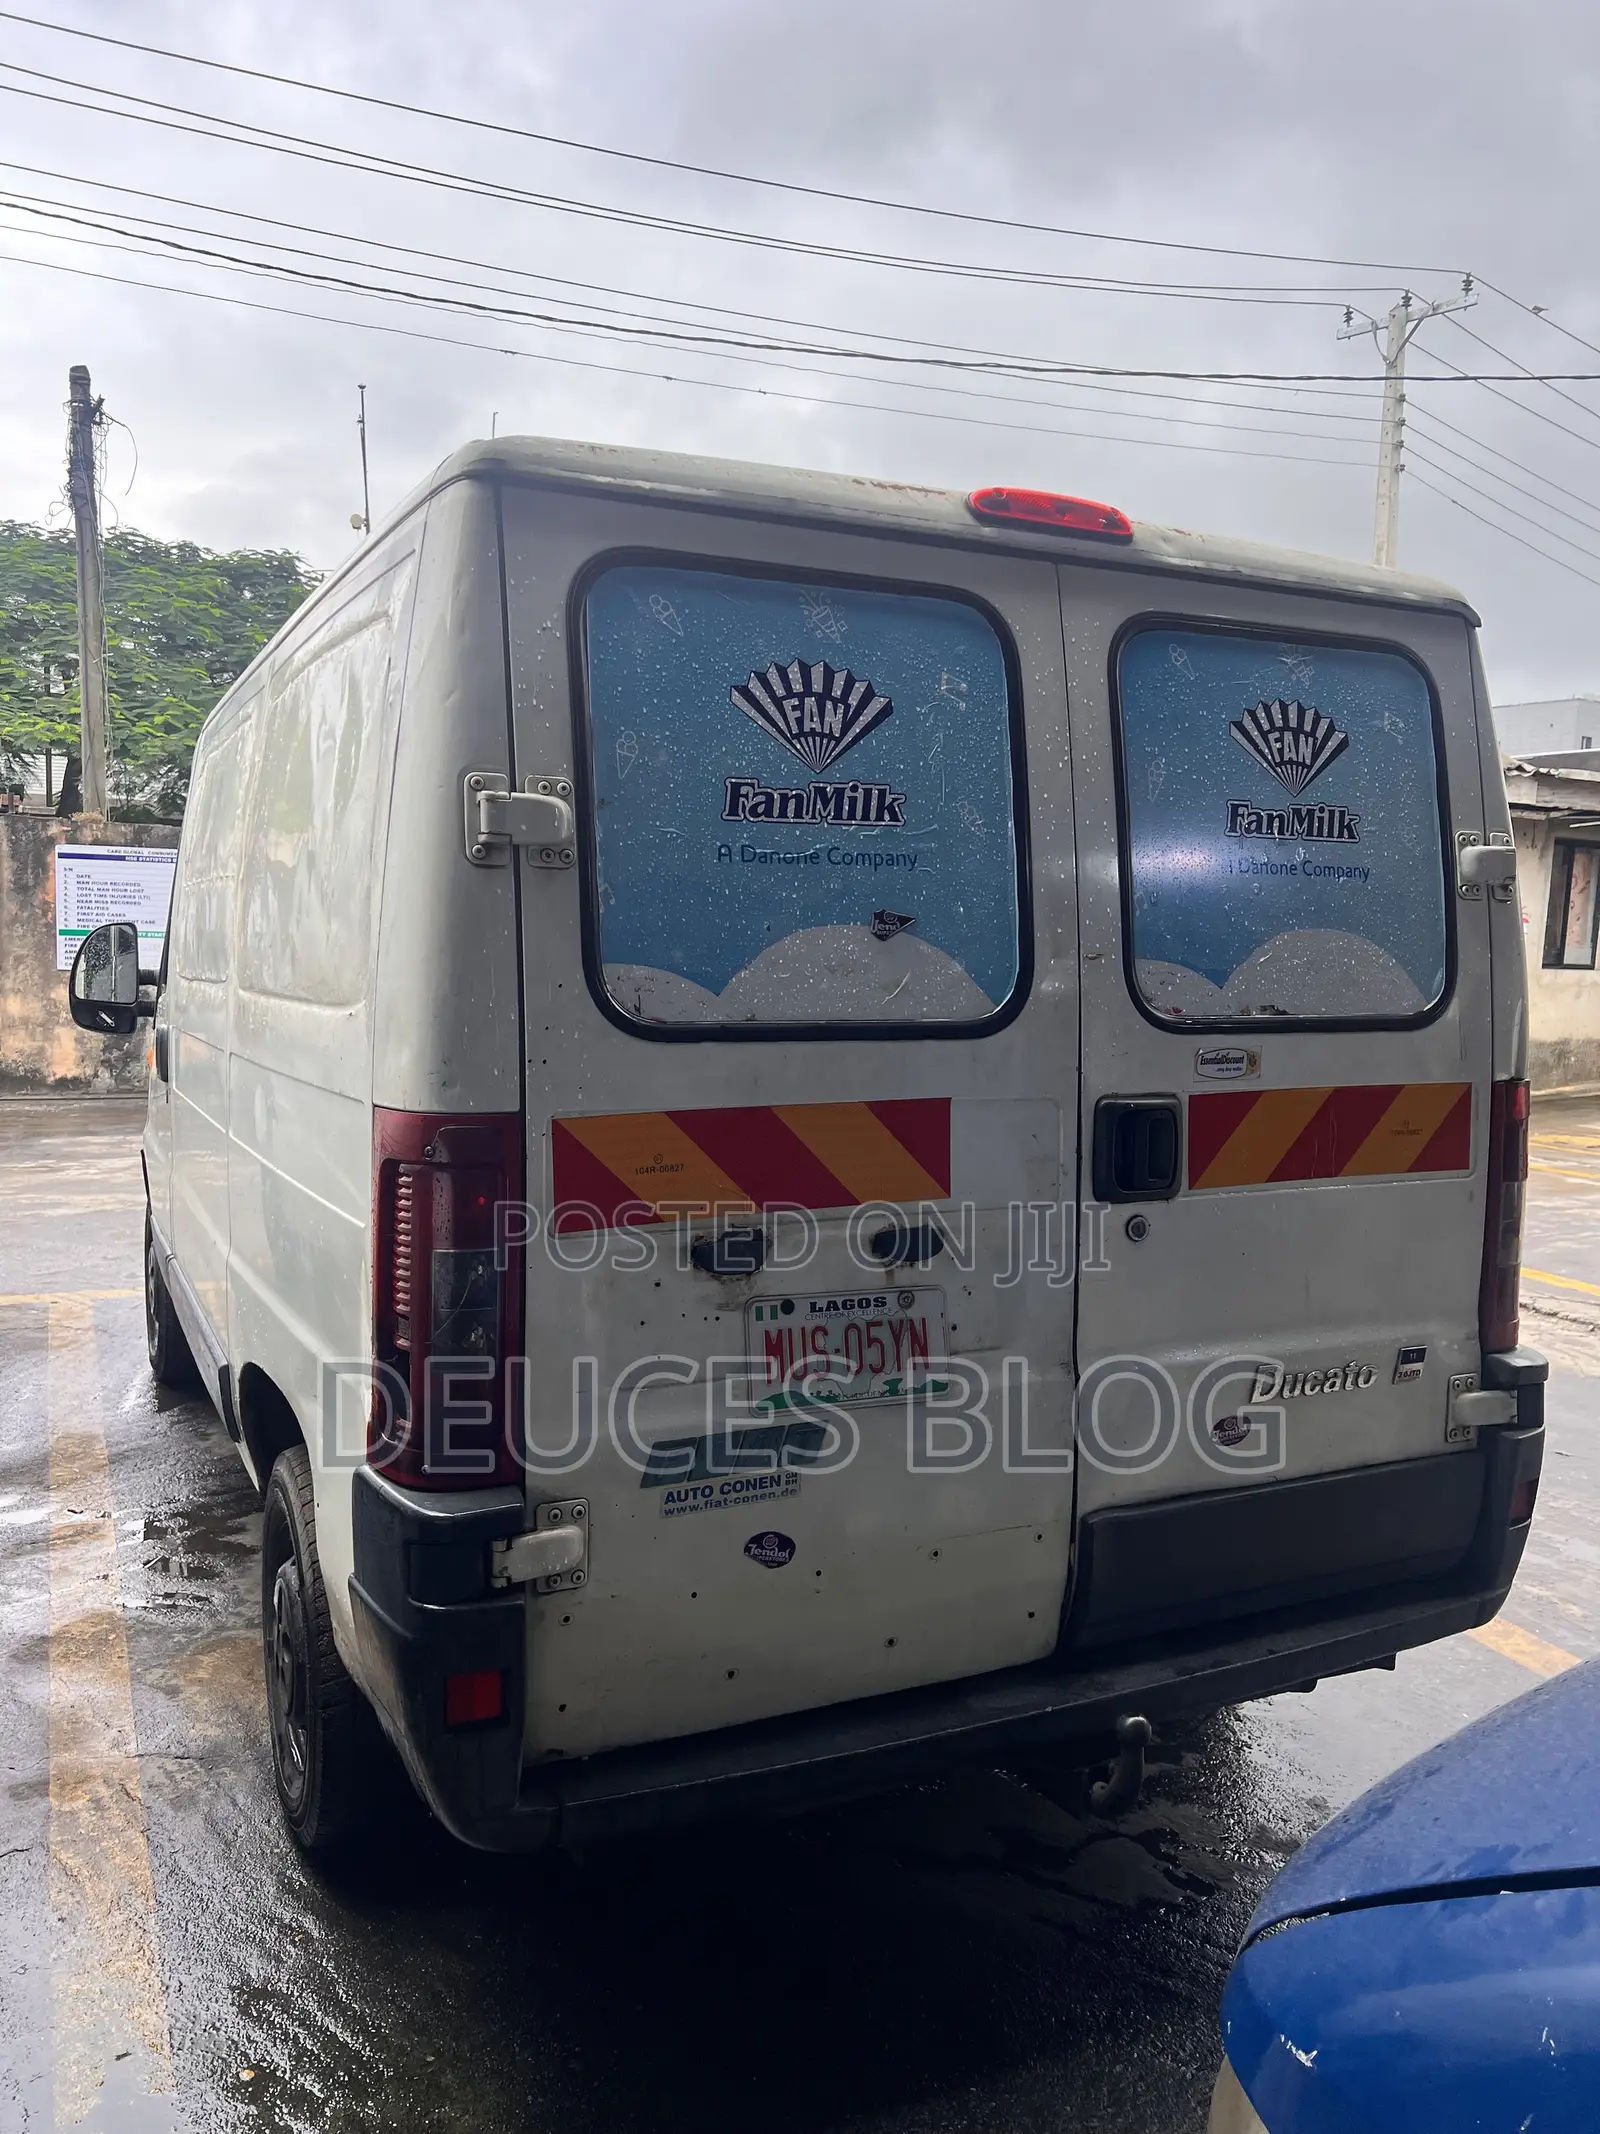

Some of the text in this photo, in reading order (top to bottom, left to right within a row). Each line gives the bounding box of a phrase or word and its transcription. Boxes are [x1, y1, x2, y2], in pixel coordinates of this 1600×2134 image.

[783, 696, 845, 737] FAN
[1268, 731, 1316, 766] FAN
[717, 844, 918, 872] A Danone Company
[1302, 860, 1370, 883] Company
[635, 1164, 684, 1175] 104R-00827
[809, 1296, 887, 1314] LAGOS
[848, 1307, 893, 1319] EXCELLENCE
[1250, 1360, 1380, 1404] Ducato
[663, 1487, 798, 1517] www.fiat-conen.de
[664, 1474, 781, 1505] AUTO CONEN
